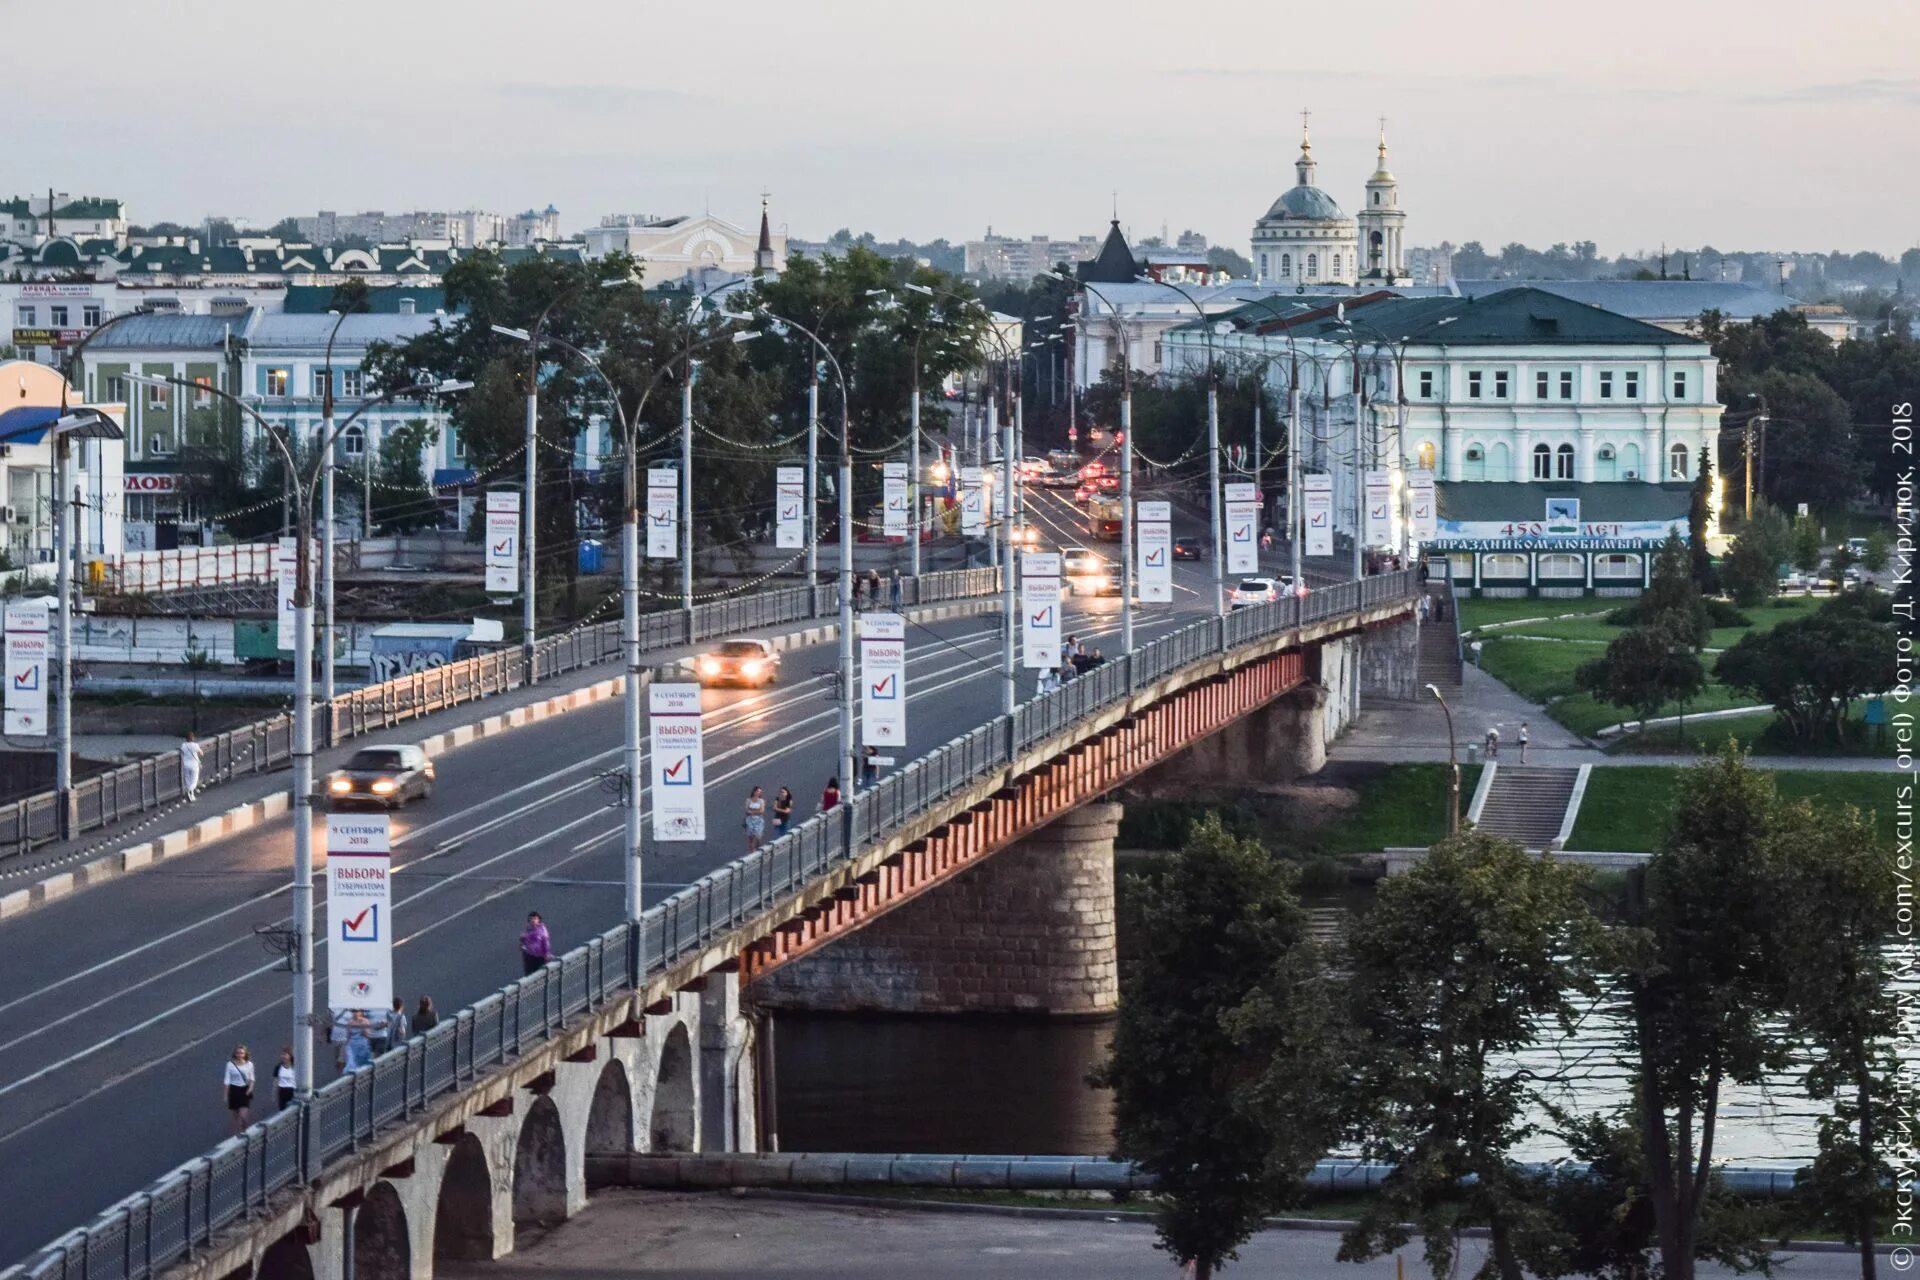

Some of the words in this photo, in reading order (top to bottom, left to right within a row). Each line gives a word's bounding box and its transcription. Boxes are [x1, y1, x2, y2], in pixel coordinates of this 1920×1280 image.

[1501, 523, 1542, 537] 450
[1554, 537, 1643, 549] ЛЮБИМЫЙ
[868, 649, 901, 657] ВЫБОРЫ
[659, 725, 697, 735] ВЫБОРЫ
[332, 826, 338, 834] 9
[340, 826, 384, 835] СЕНТЯБРЯ
[349, 836, 369, 845] 2018
[337, 867, 385, 879] ВЫБОРЫ
